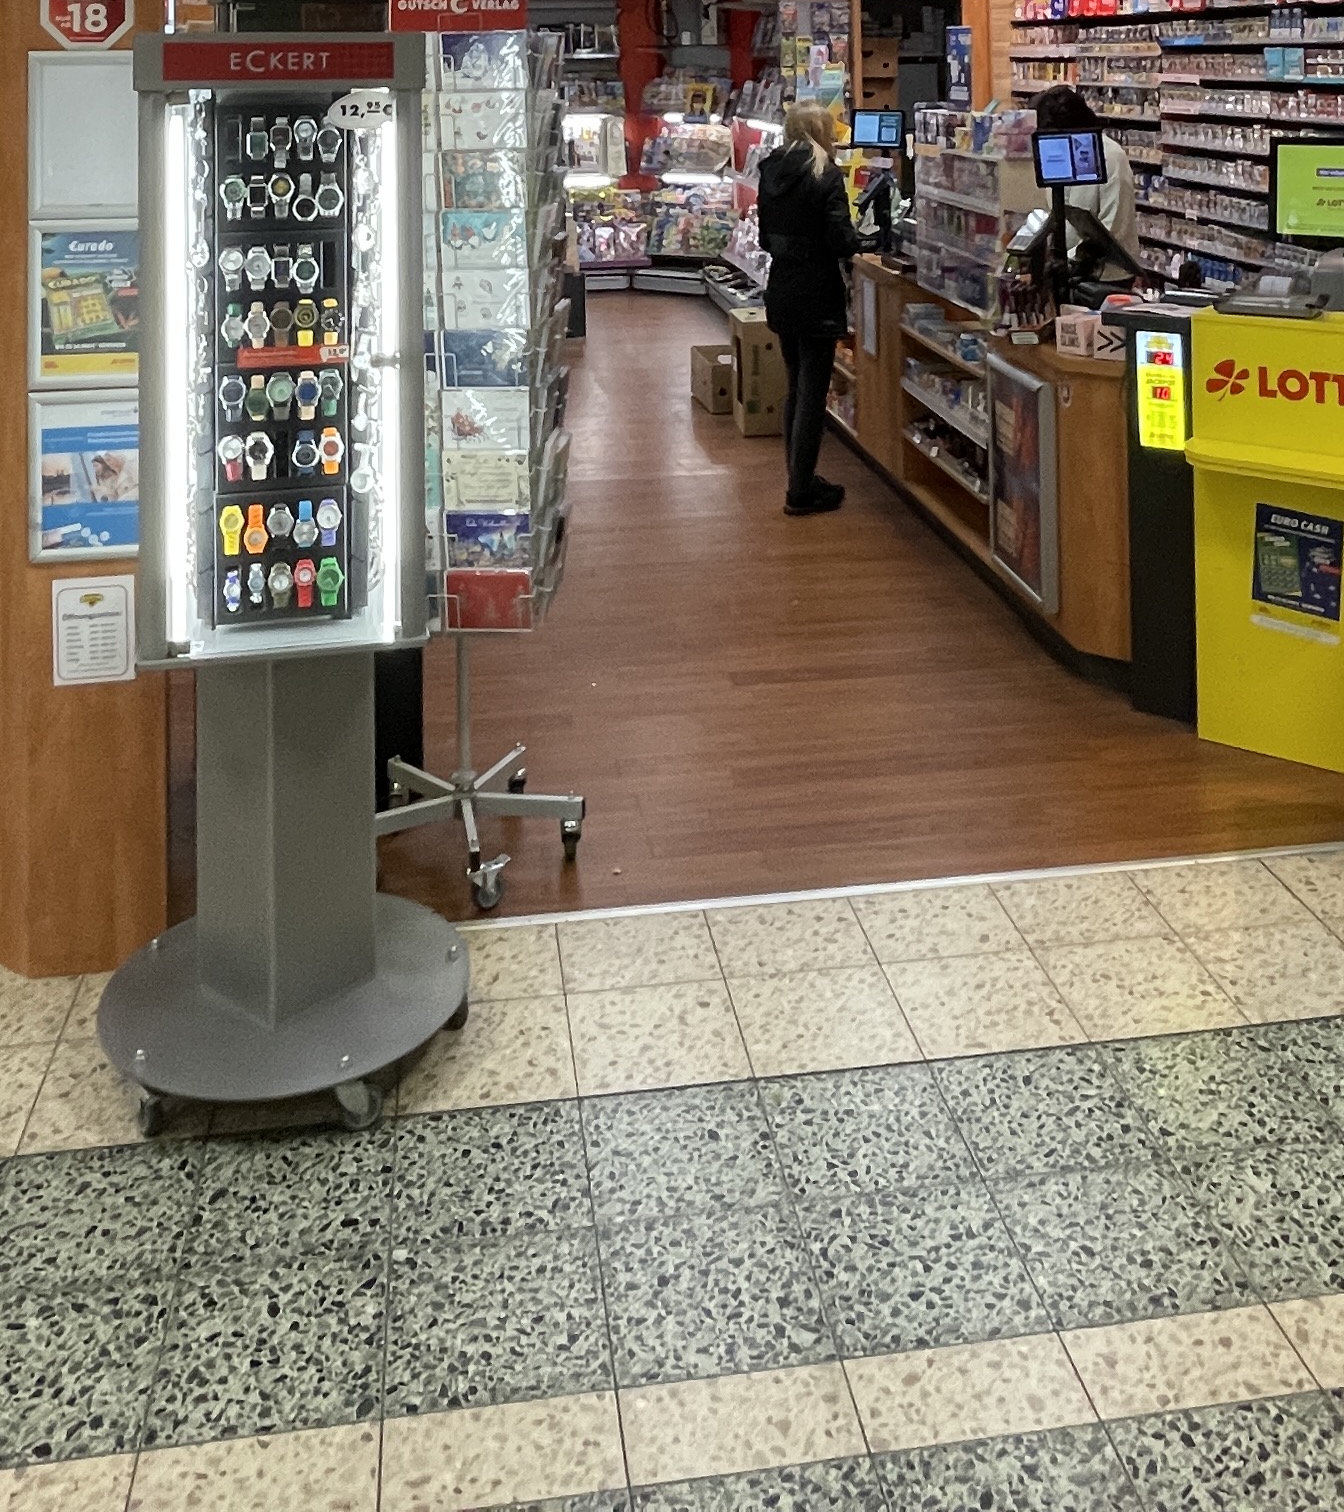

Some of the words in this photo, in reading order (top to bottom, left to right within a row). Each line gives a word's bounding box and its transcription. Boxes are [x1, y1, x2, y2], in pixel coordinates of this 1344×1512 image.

[397, 0, 448, 11] GUTSCH
[67, 2, 108, 33] 18
[229, 49, 331, 72] ECKERT
[1155, 352, 1174, 366] 24
[1271, 514, 1299, 528] EURO
[1301, 520, 1329, 535] CASH
